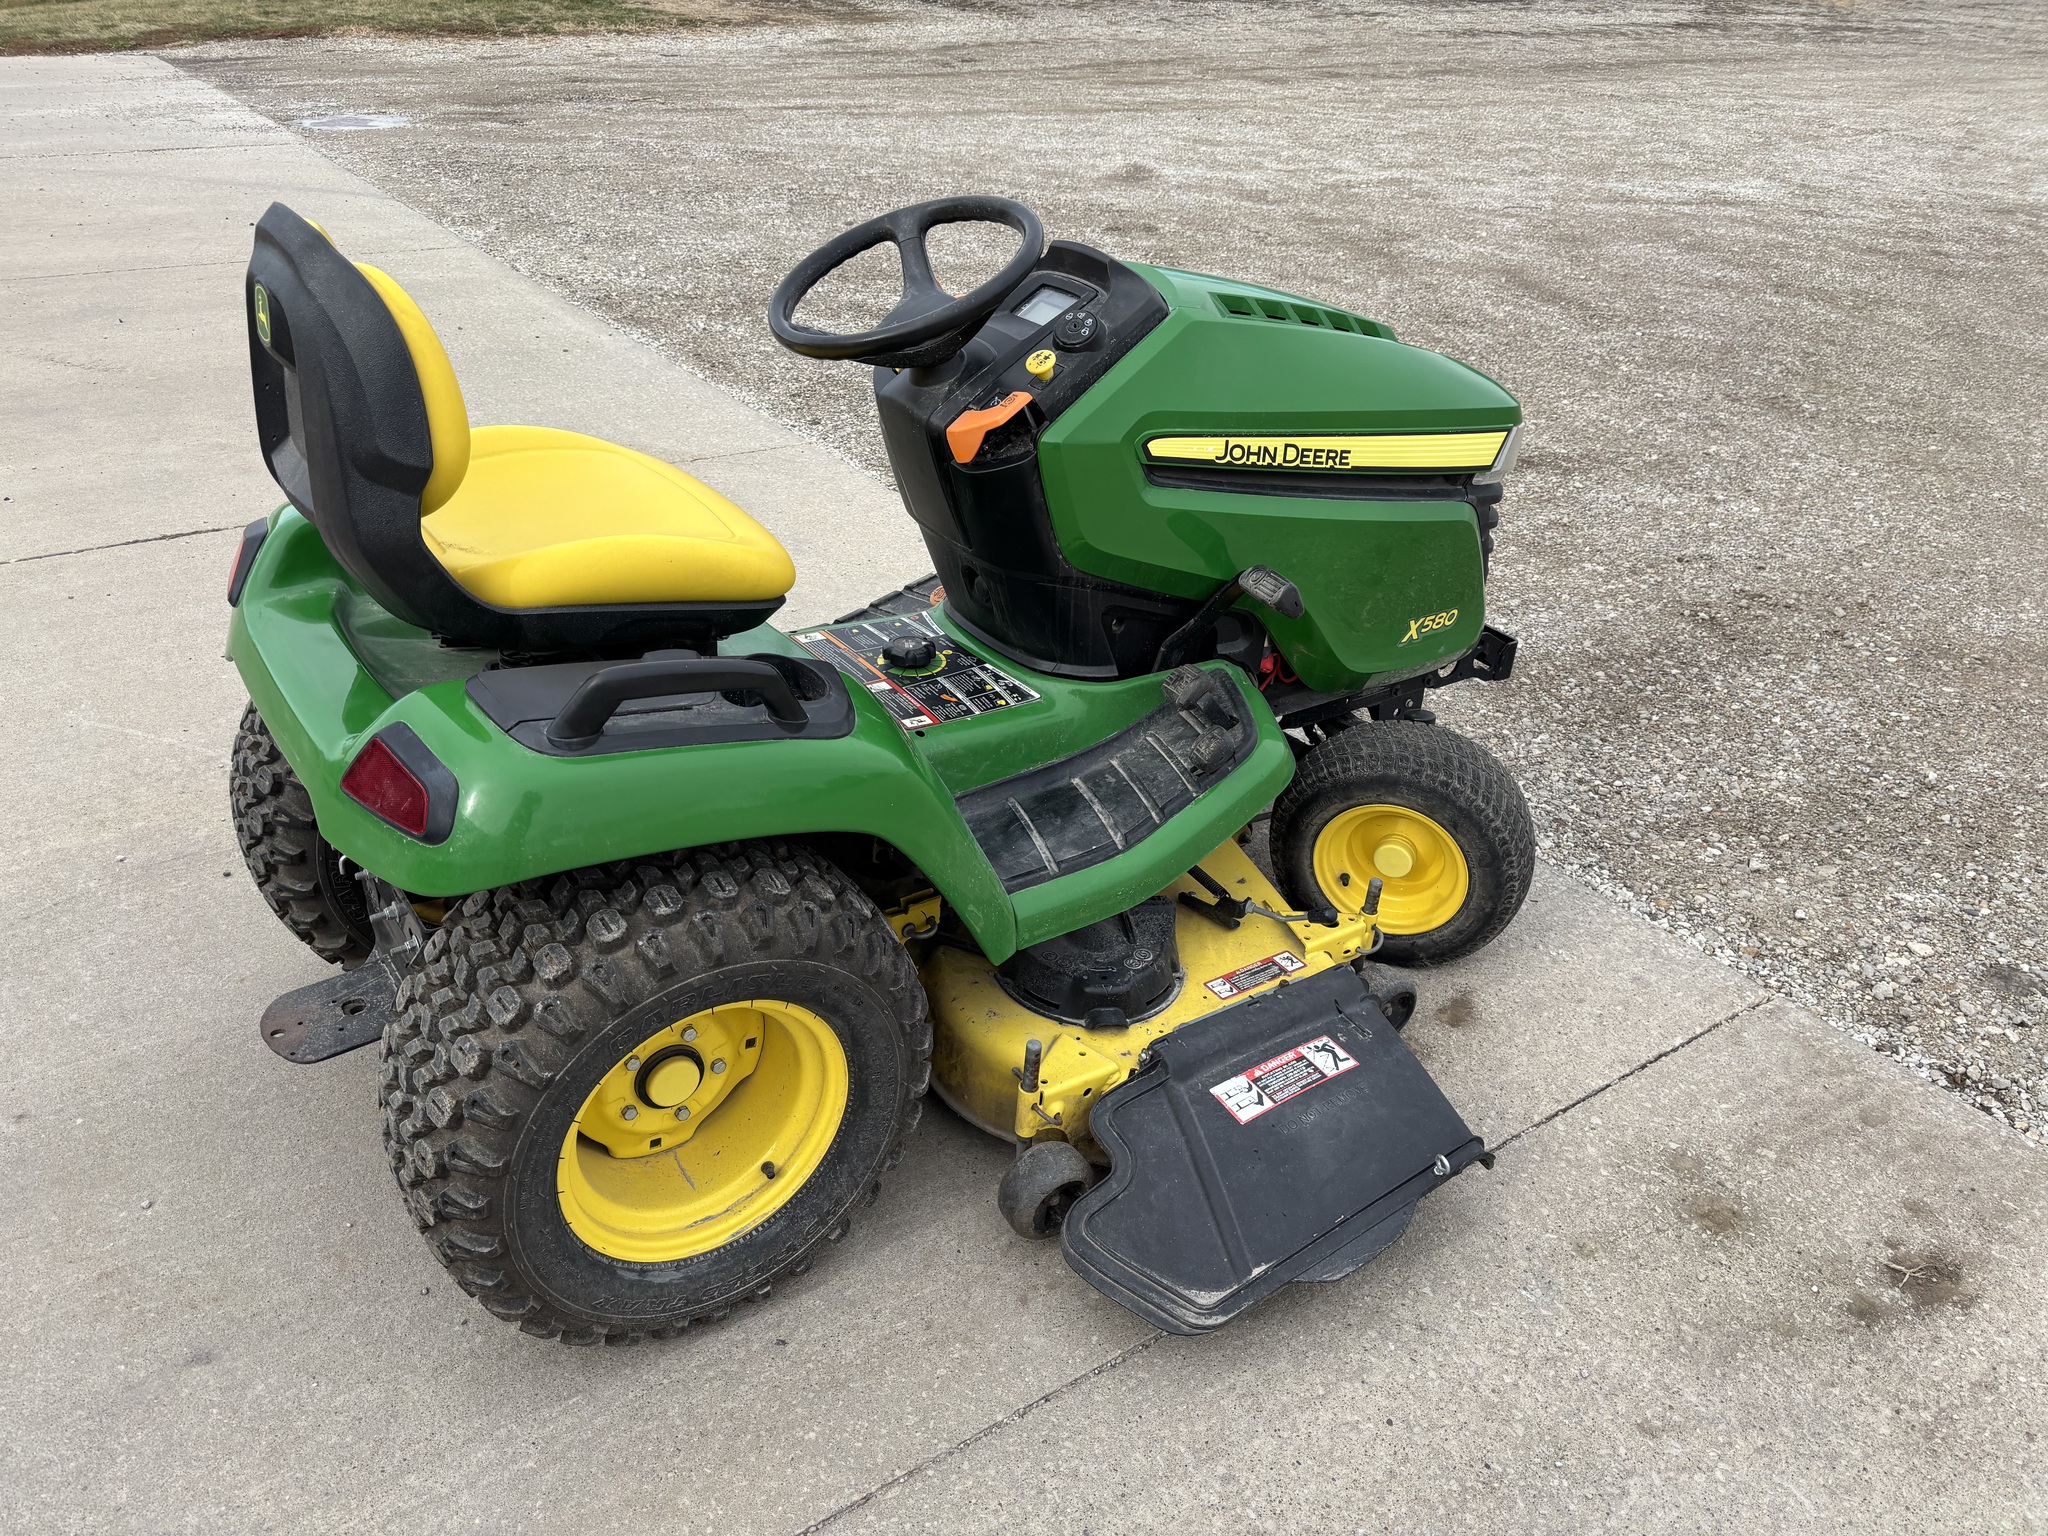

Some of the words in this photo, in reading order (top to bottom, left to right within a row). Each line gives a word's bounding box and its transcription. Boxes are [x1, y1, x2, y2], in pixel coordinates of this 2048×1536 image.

[1215, 439, 1278, 464] JOHN
[1282, 443, 1351, 467] DEERE
[1400, 608, 1459, 643] X580
[608, 972, 822, 1057] CARLISLE
[1260, 1051, 1297, 1073] DANGER
[1279, 1120, 1298, 1134] DO
[1298, 1105, 1322, 1125] NOT
[1322, 1081, 1370, 1111] REMOVE
[592, 1295, 687, 1311] TRAX
